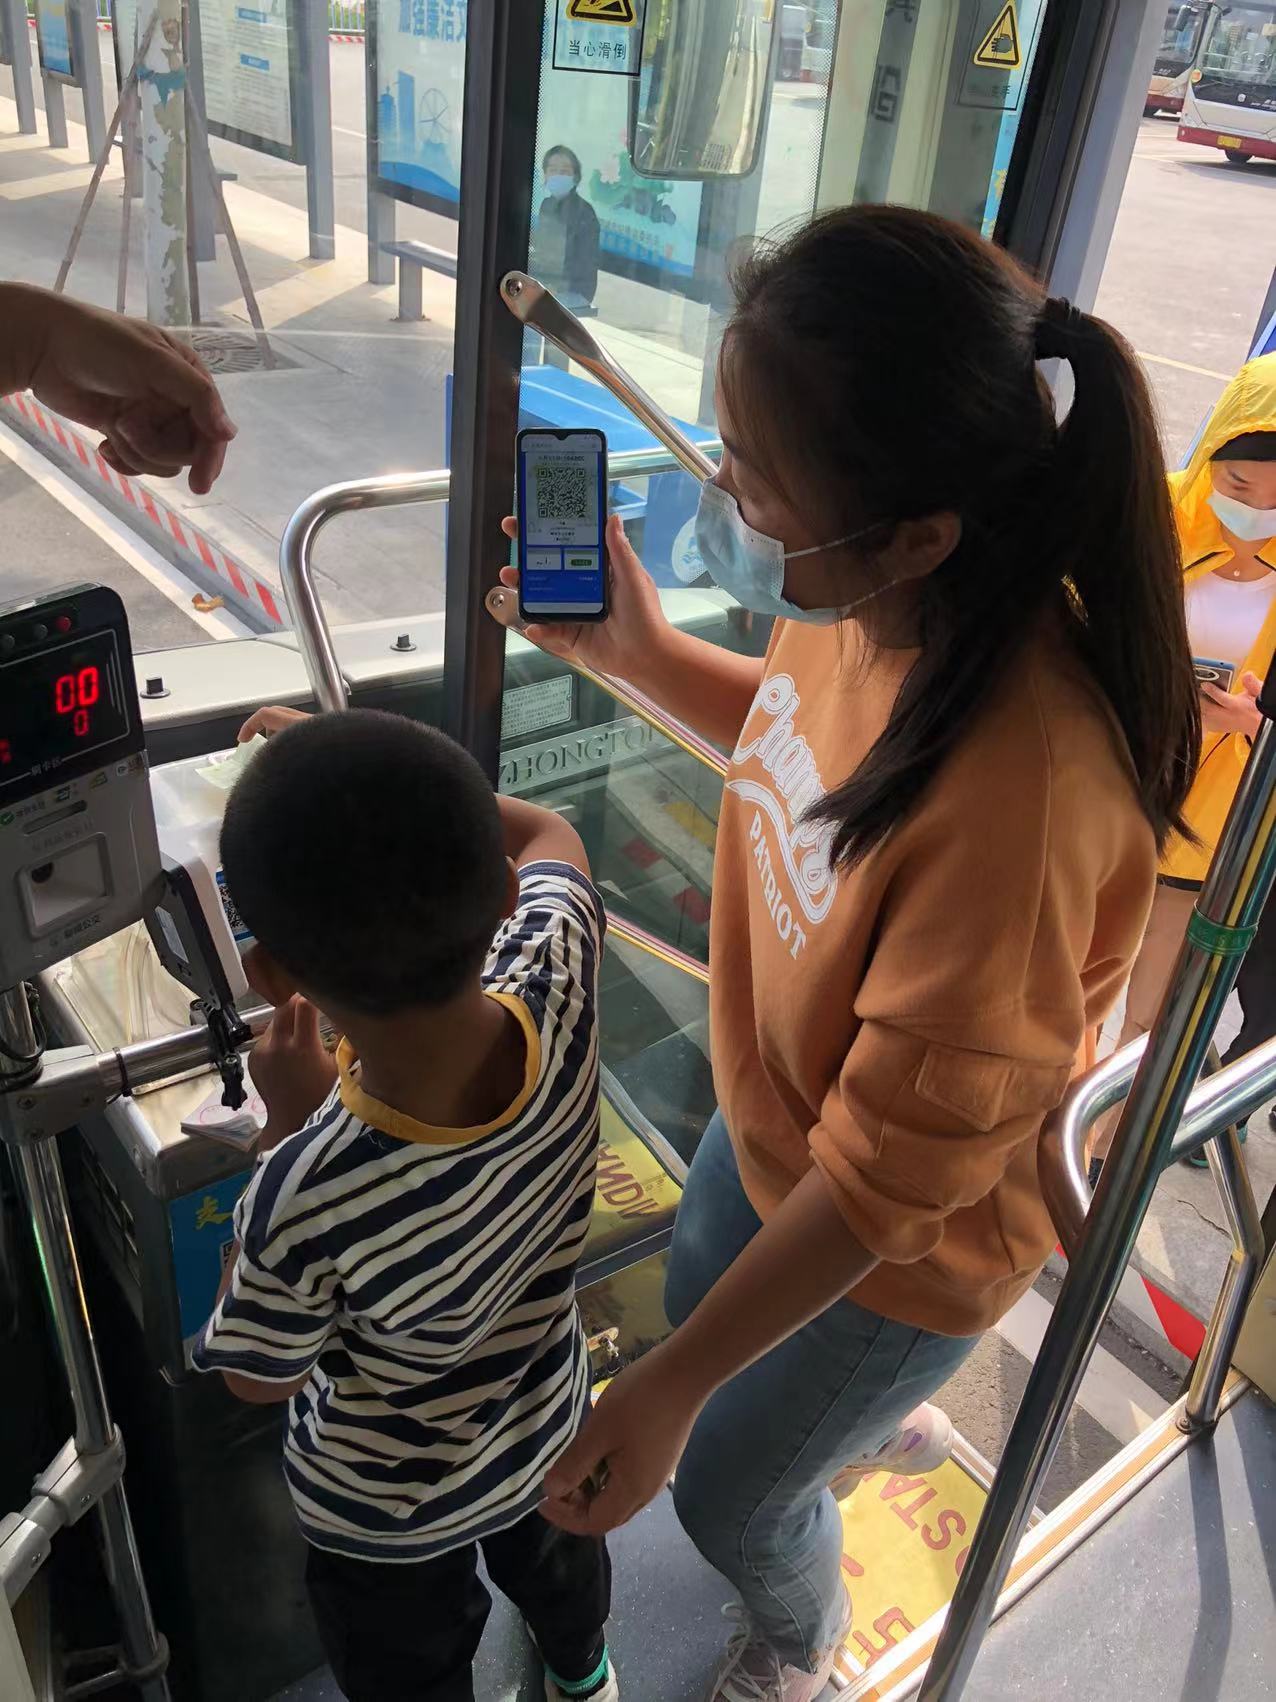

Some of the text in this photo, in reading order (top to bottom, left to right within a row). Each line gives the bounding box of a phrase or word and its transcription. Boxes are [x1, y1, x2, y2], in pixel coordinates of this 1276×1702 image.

[568, 39, 627, 60] 当心滑倒
[55, 666, 99, 714] 00
[750, 810, 807, 960] PATRIOT
